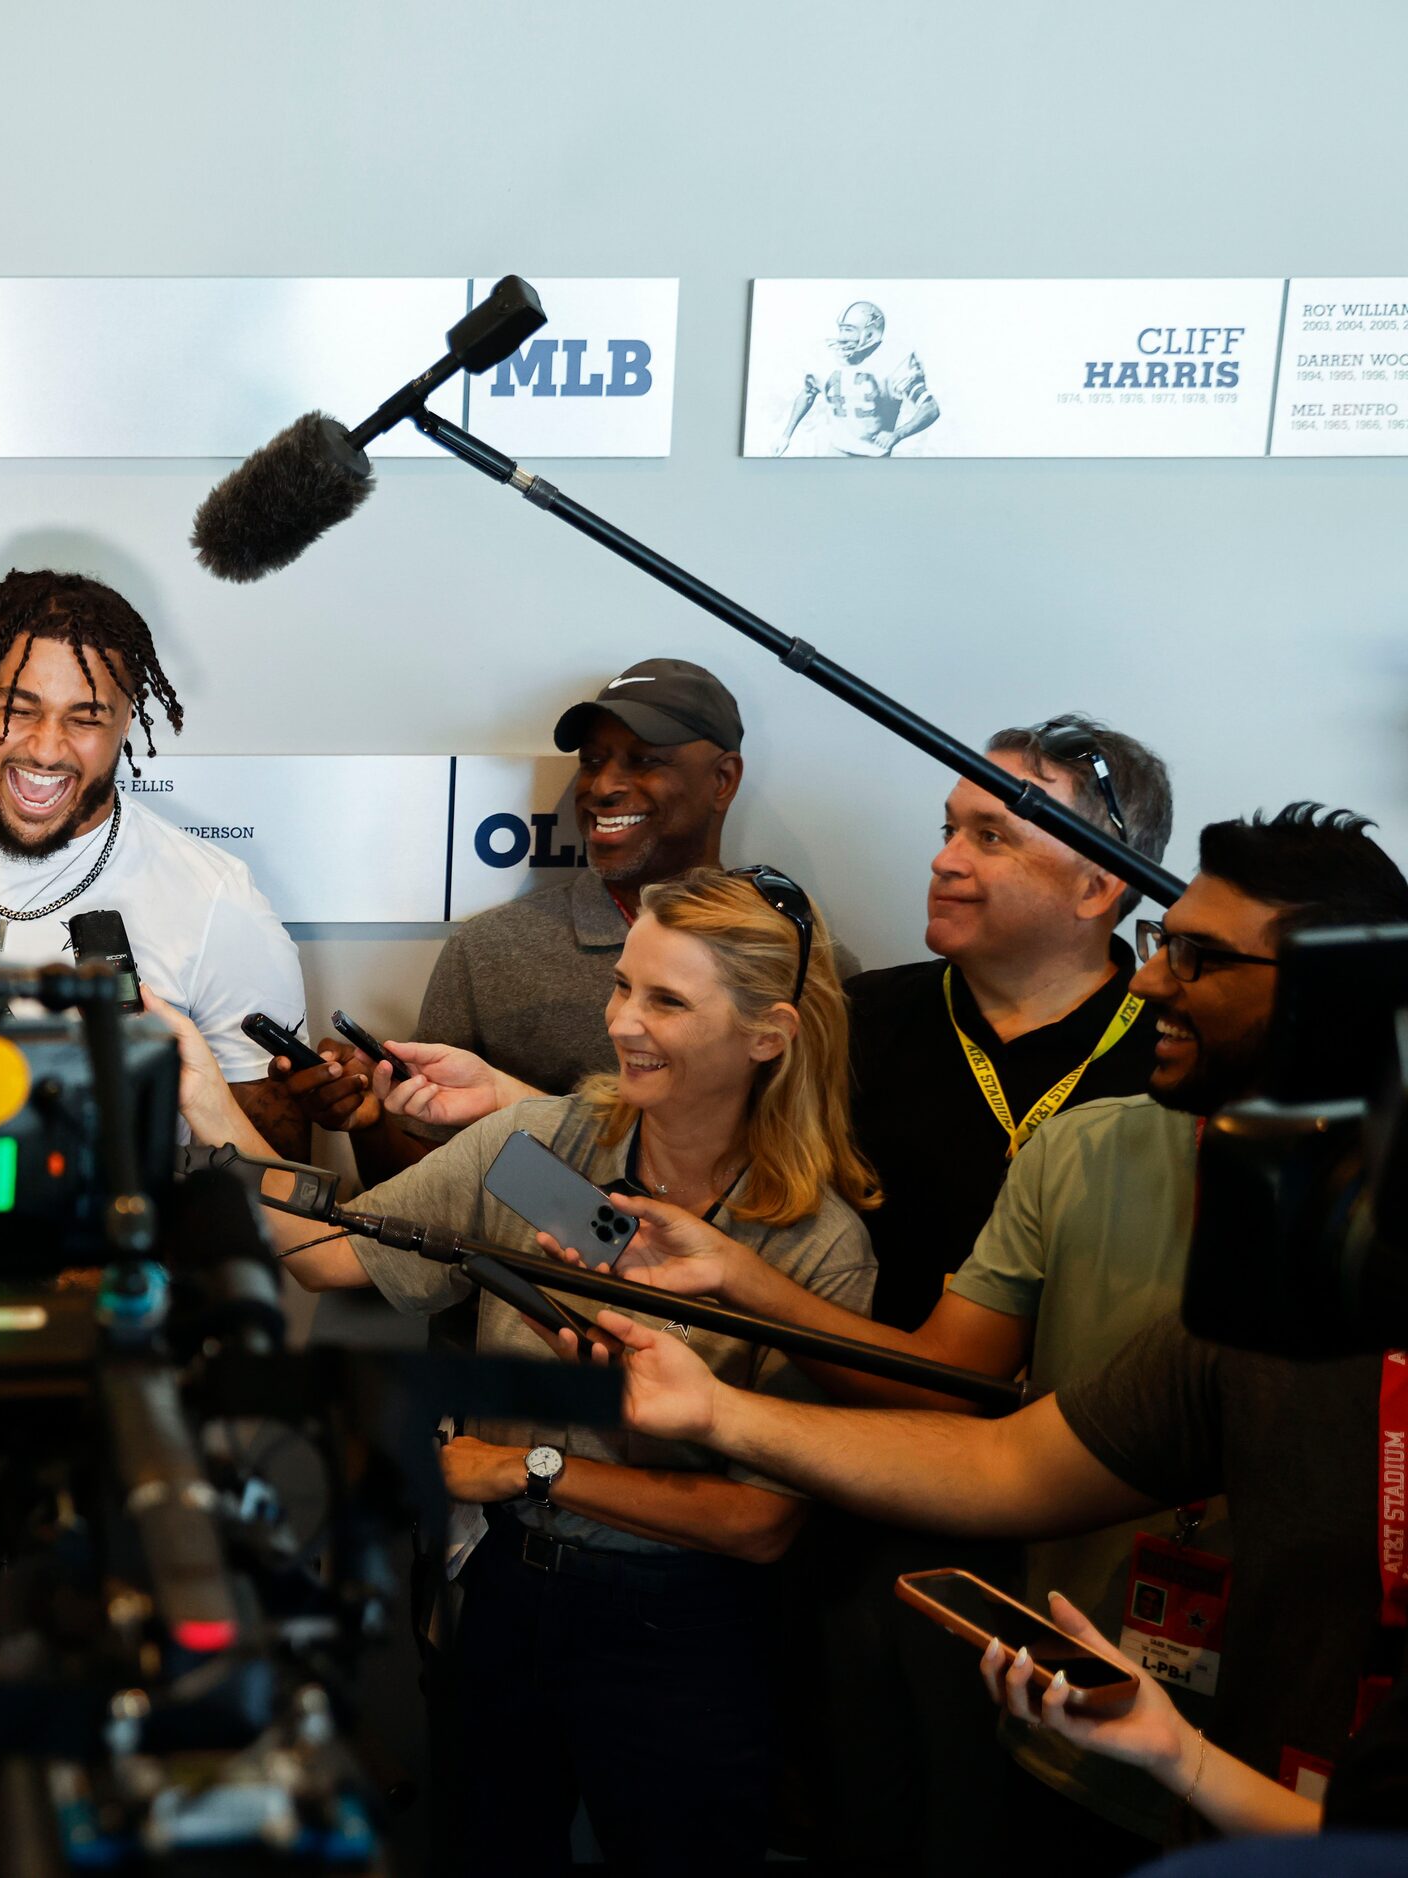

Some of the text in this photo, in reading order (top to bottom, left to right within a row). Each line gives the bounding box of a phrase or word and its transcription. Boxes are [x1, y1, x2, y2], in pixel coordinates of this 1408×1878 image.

[1302, 304, 1336, 316] ROY
[1138, 327, 1245, 355] CLIFF
[491, 340, 652, 396] MLB
[1083, 361, 1239, 388] HARRIS
[1297, 354, 1364, 367] DARREN
[1291, 404, 1398, 417] MEL RENFRO
[131, 780, 174, 792] ELLIS
[474, 813, 588, 868] OL
[967, 1044, 1013, 1130] AT&T STADIUM
[1026, 1100, 1053, 1133] AT&T
[1384, 1431, 1405, 1574] AT&T STADIUM
